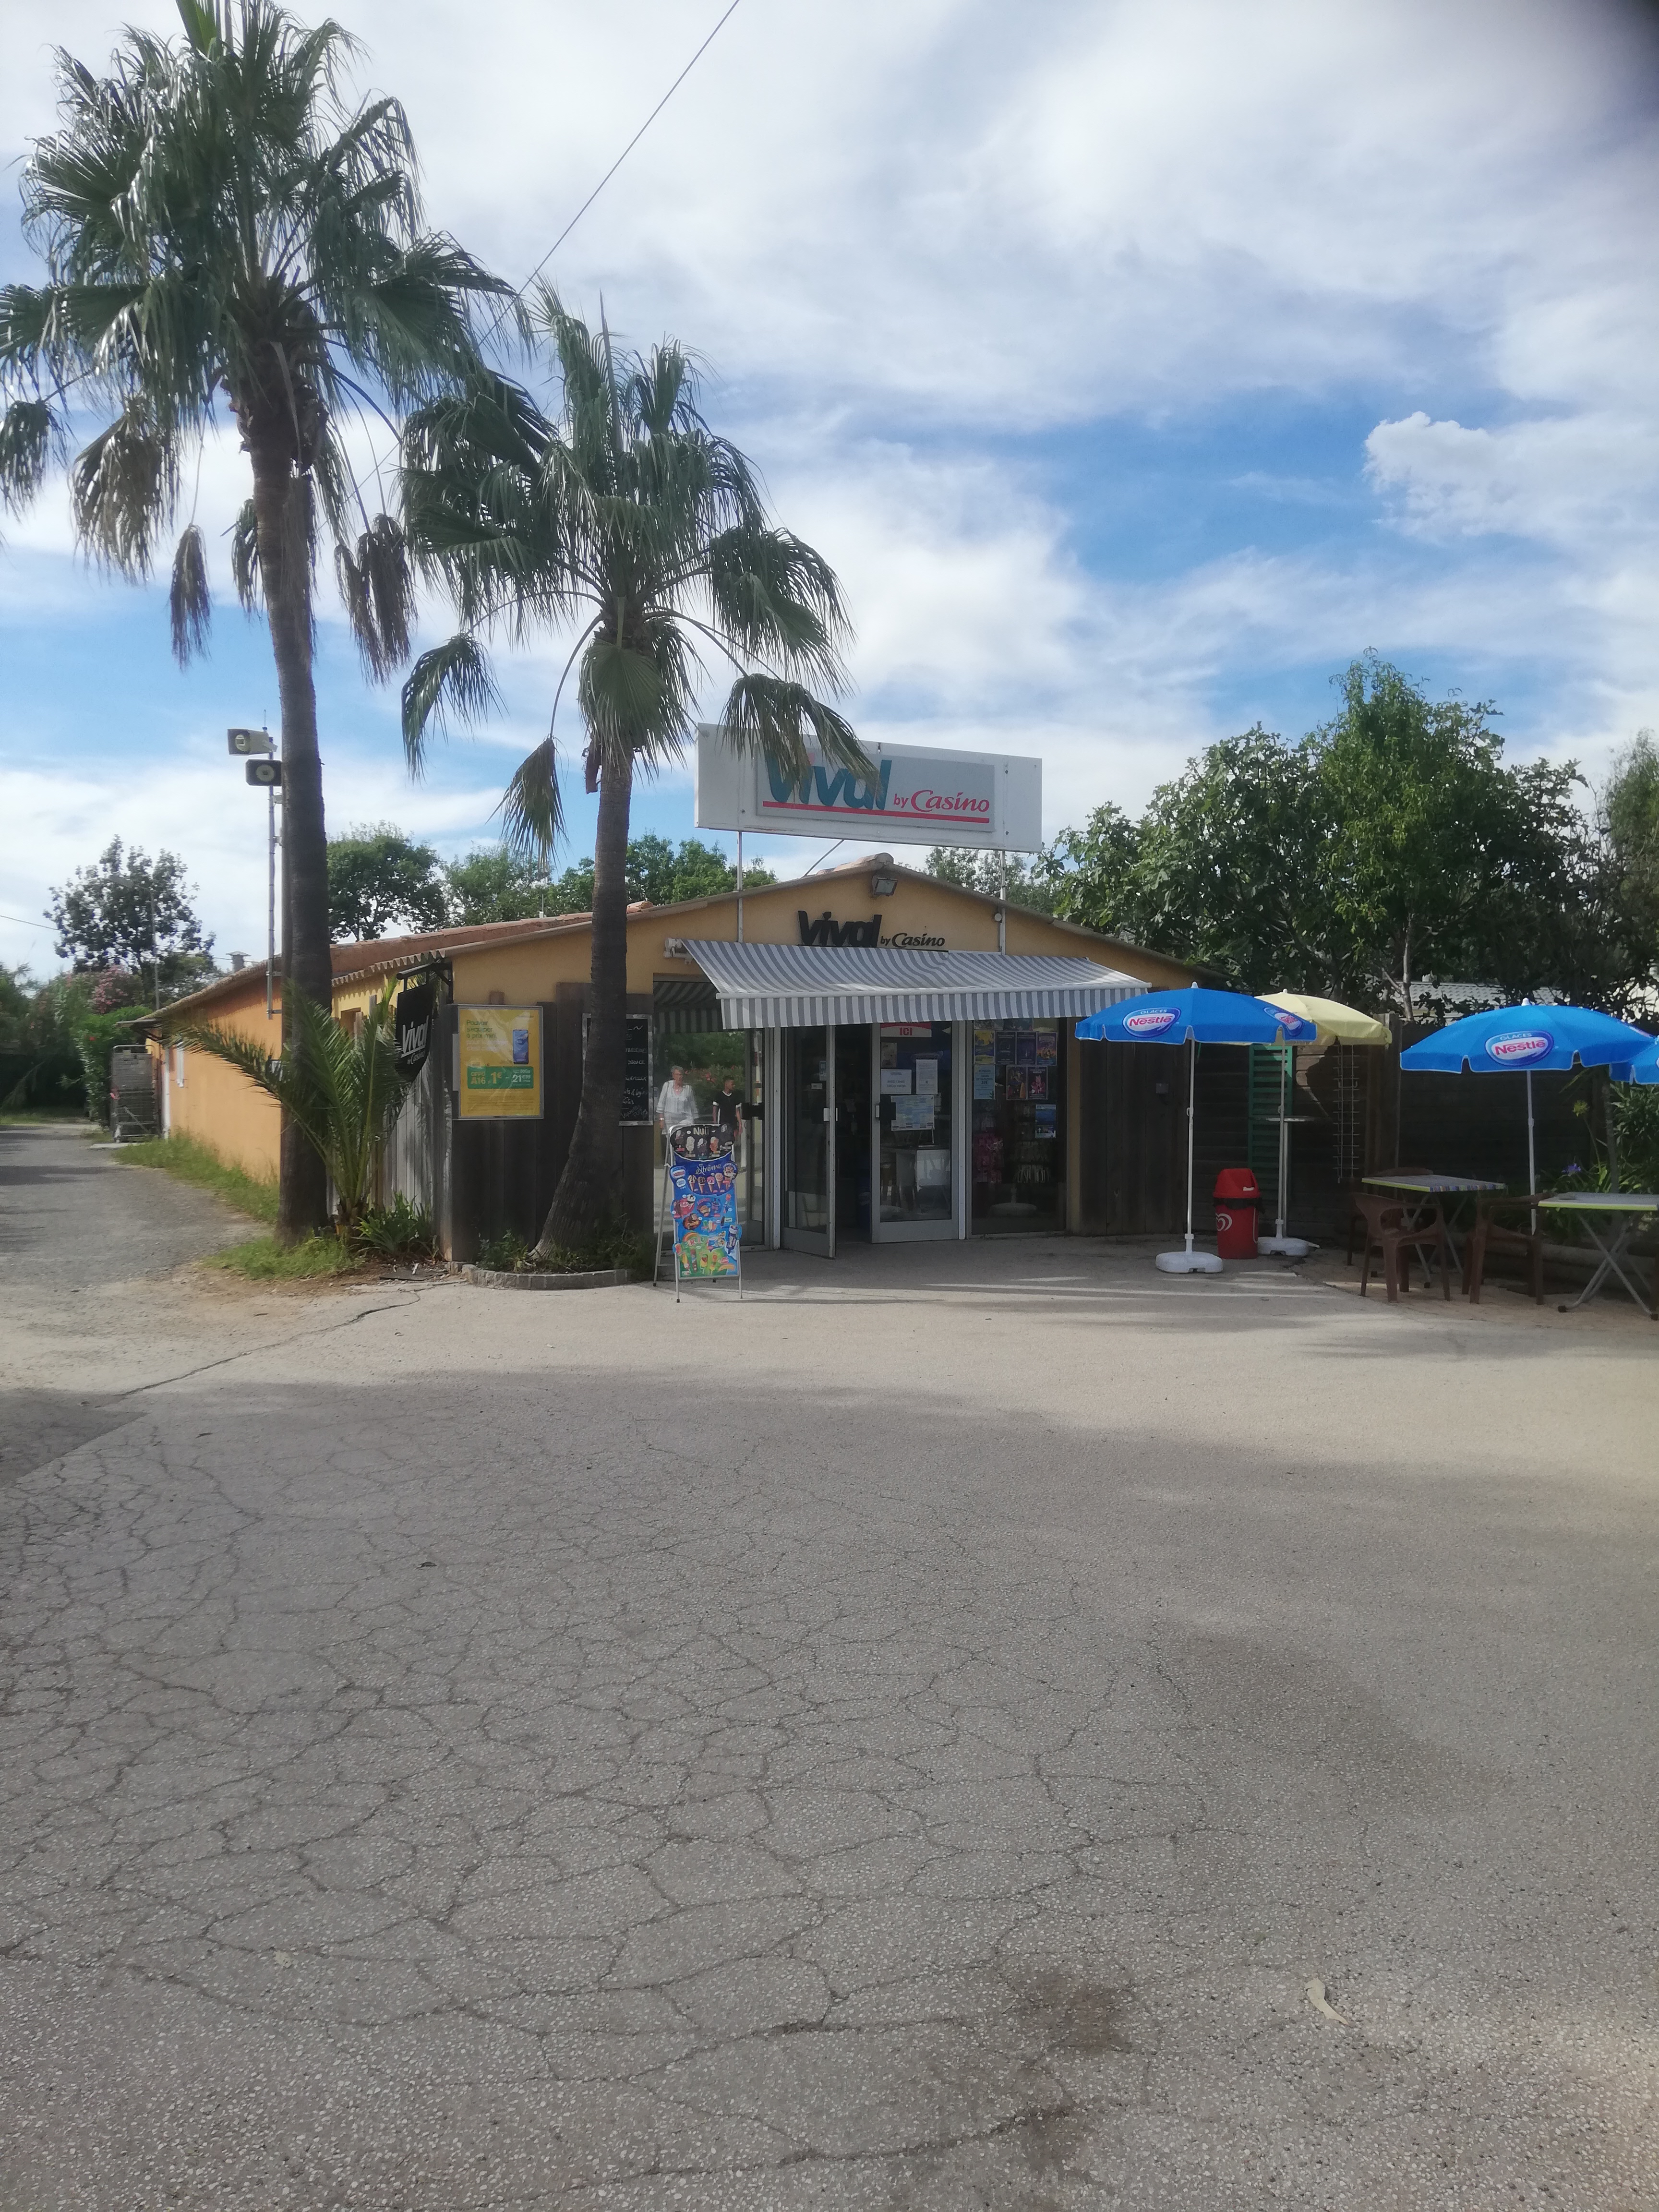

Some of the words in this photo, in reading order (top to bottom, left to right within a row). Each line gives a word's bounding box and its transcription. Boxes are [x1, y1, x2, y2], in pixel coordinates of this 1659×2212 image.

[893, 793, 909, 808] by
[910, 790, 990, 813] Casino
[880, 936, 891, 946] by
[891, 933, 945, 948] Casino
[899, 1027, 913, 1036] ICI
